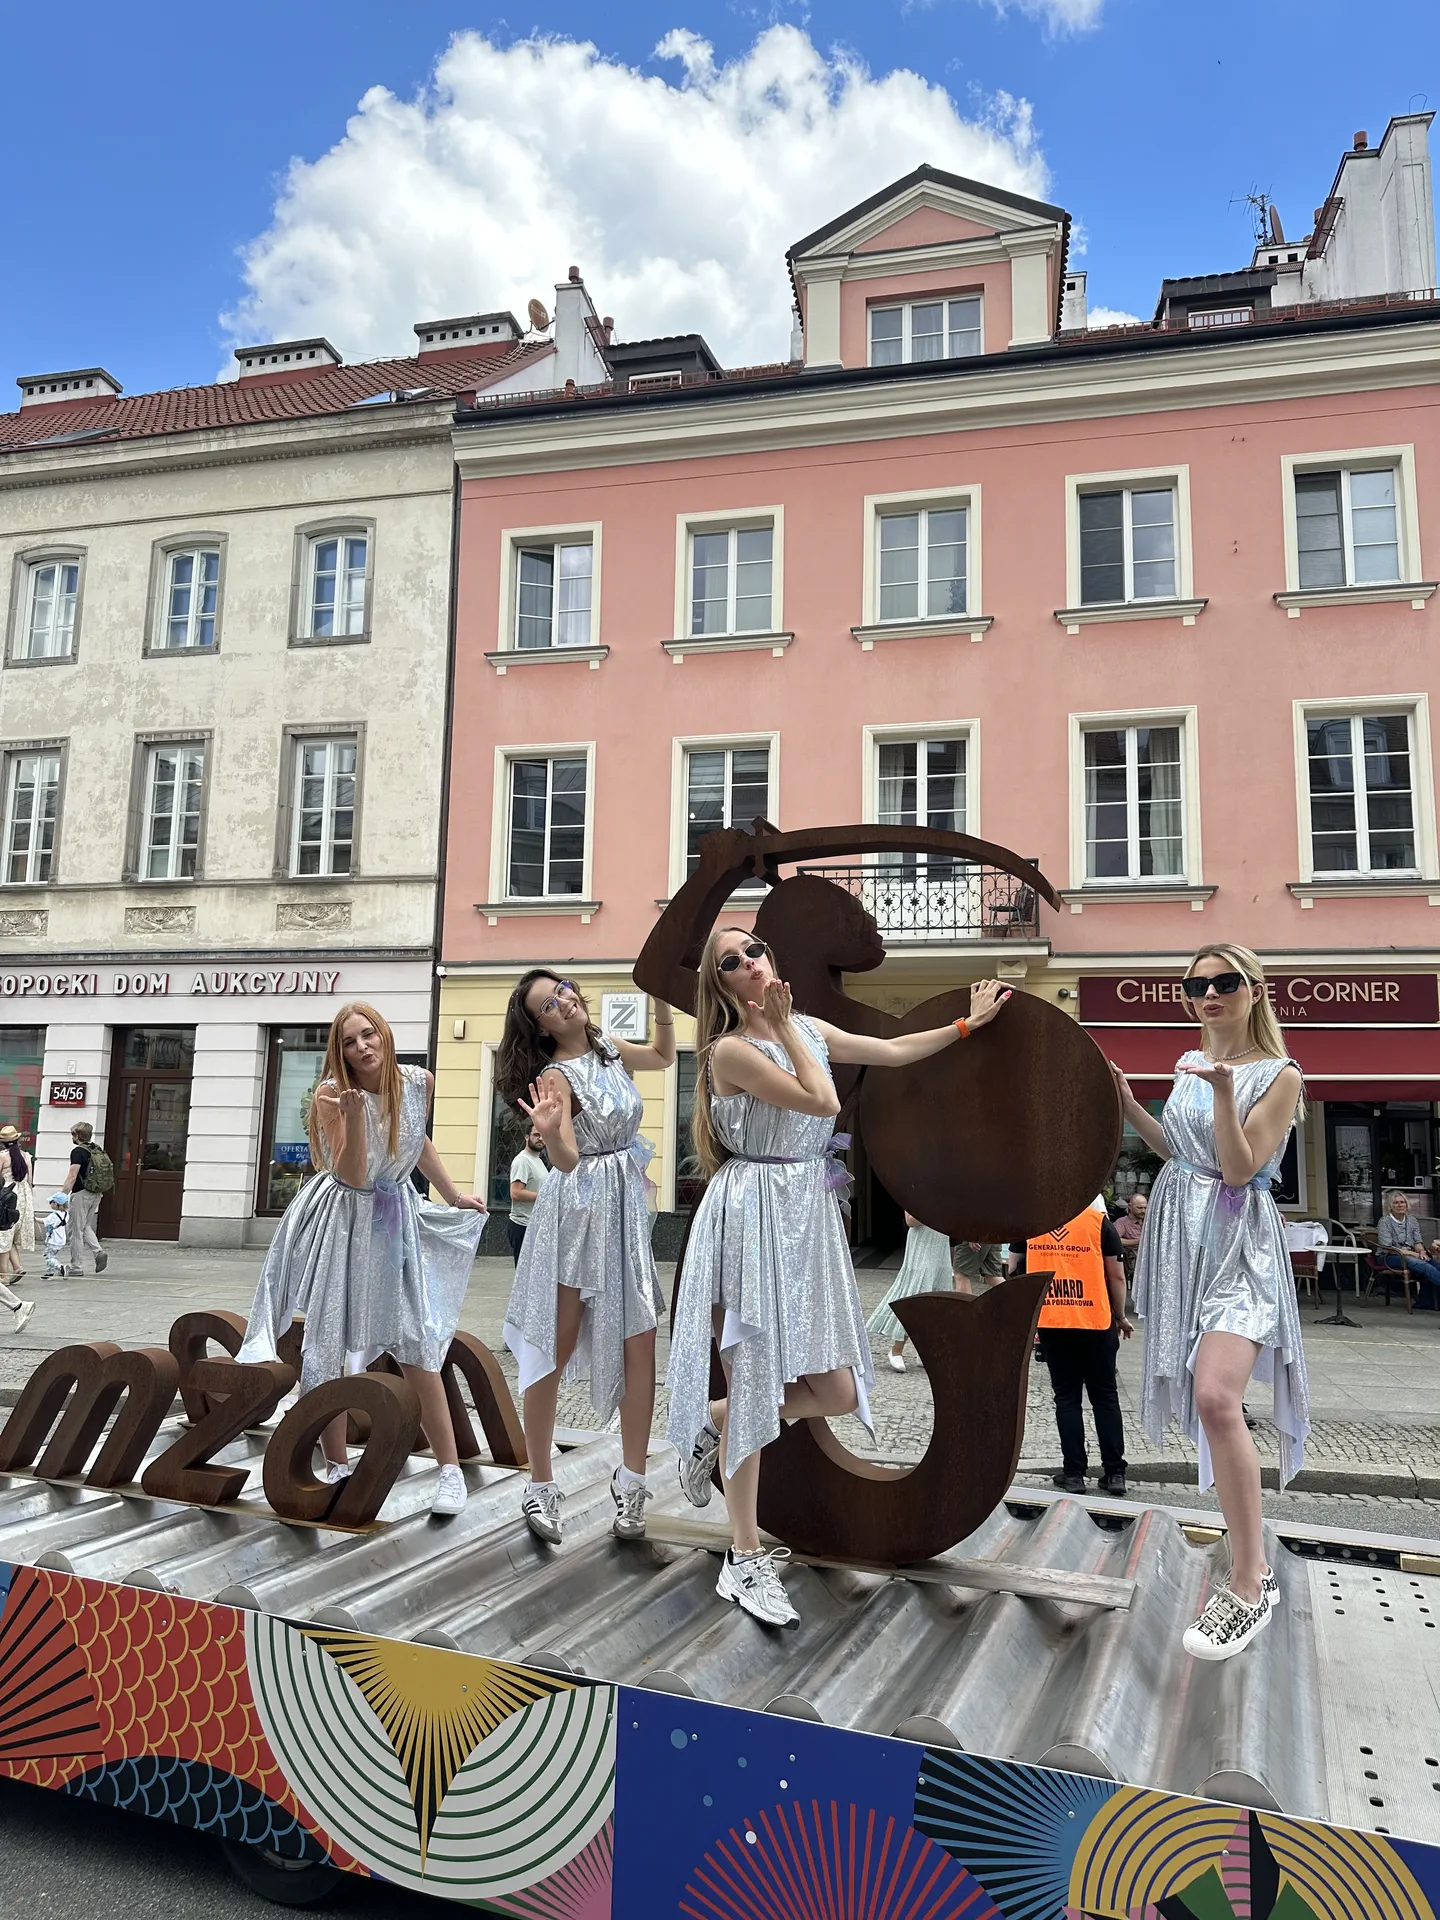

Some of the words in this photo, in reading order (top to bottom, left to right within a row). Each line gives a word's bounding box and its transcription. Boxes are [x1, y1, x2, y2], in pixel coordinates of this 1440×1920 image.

[0, 974, 98, 996] OPOCKI
[113, 973, 169, 996] DOM
[190, 972, 340, 995] AUKCYJNY
[1287, 978, 1400, 1003] CORNER
[53, 1086, 84, 1101] 54/56
[1028, 1243, 1065, 1251] GENERALIS
[1065, 1245, 1091, 1253] GROUP
[1045, 1278, 1084, 1299] EWARD
